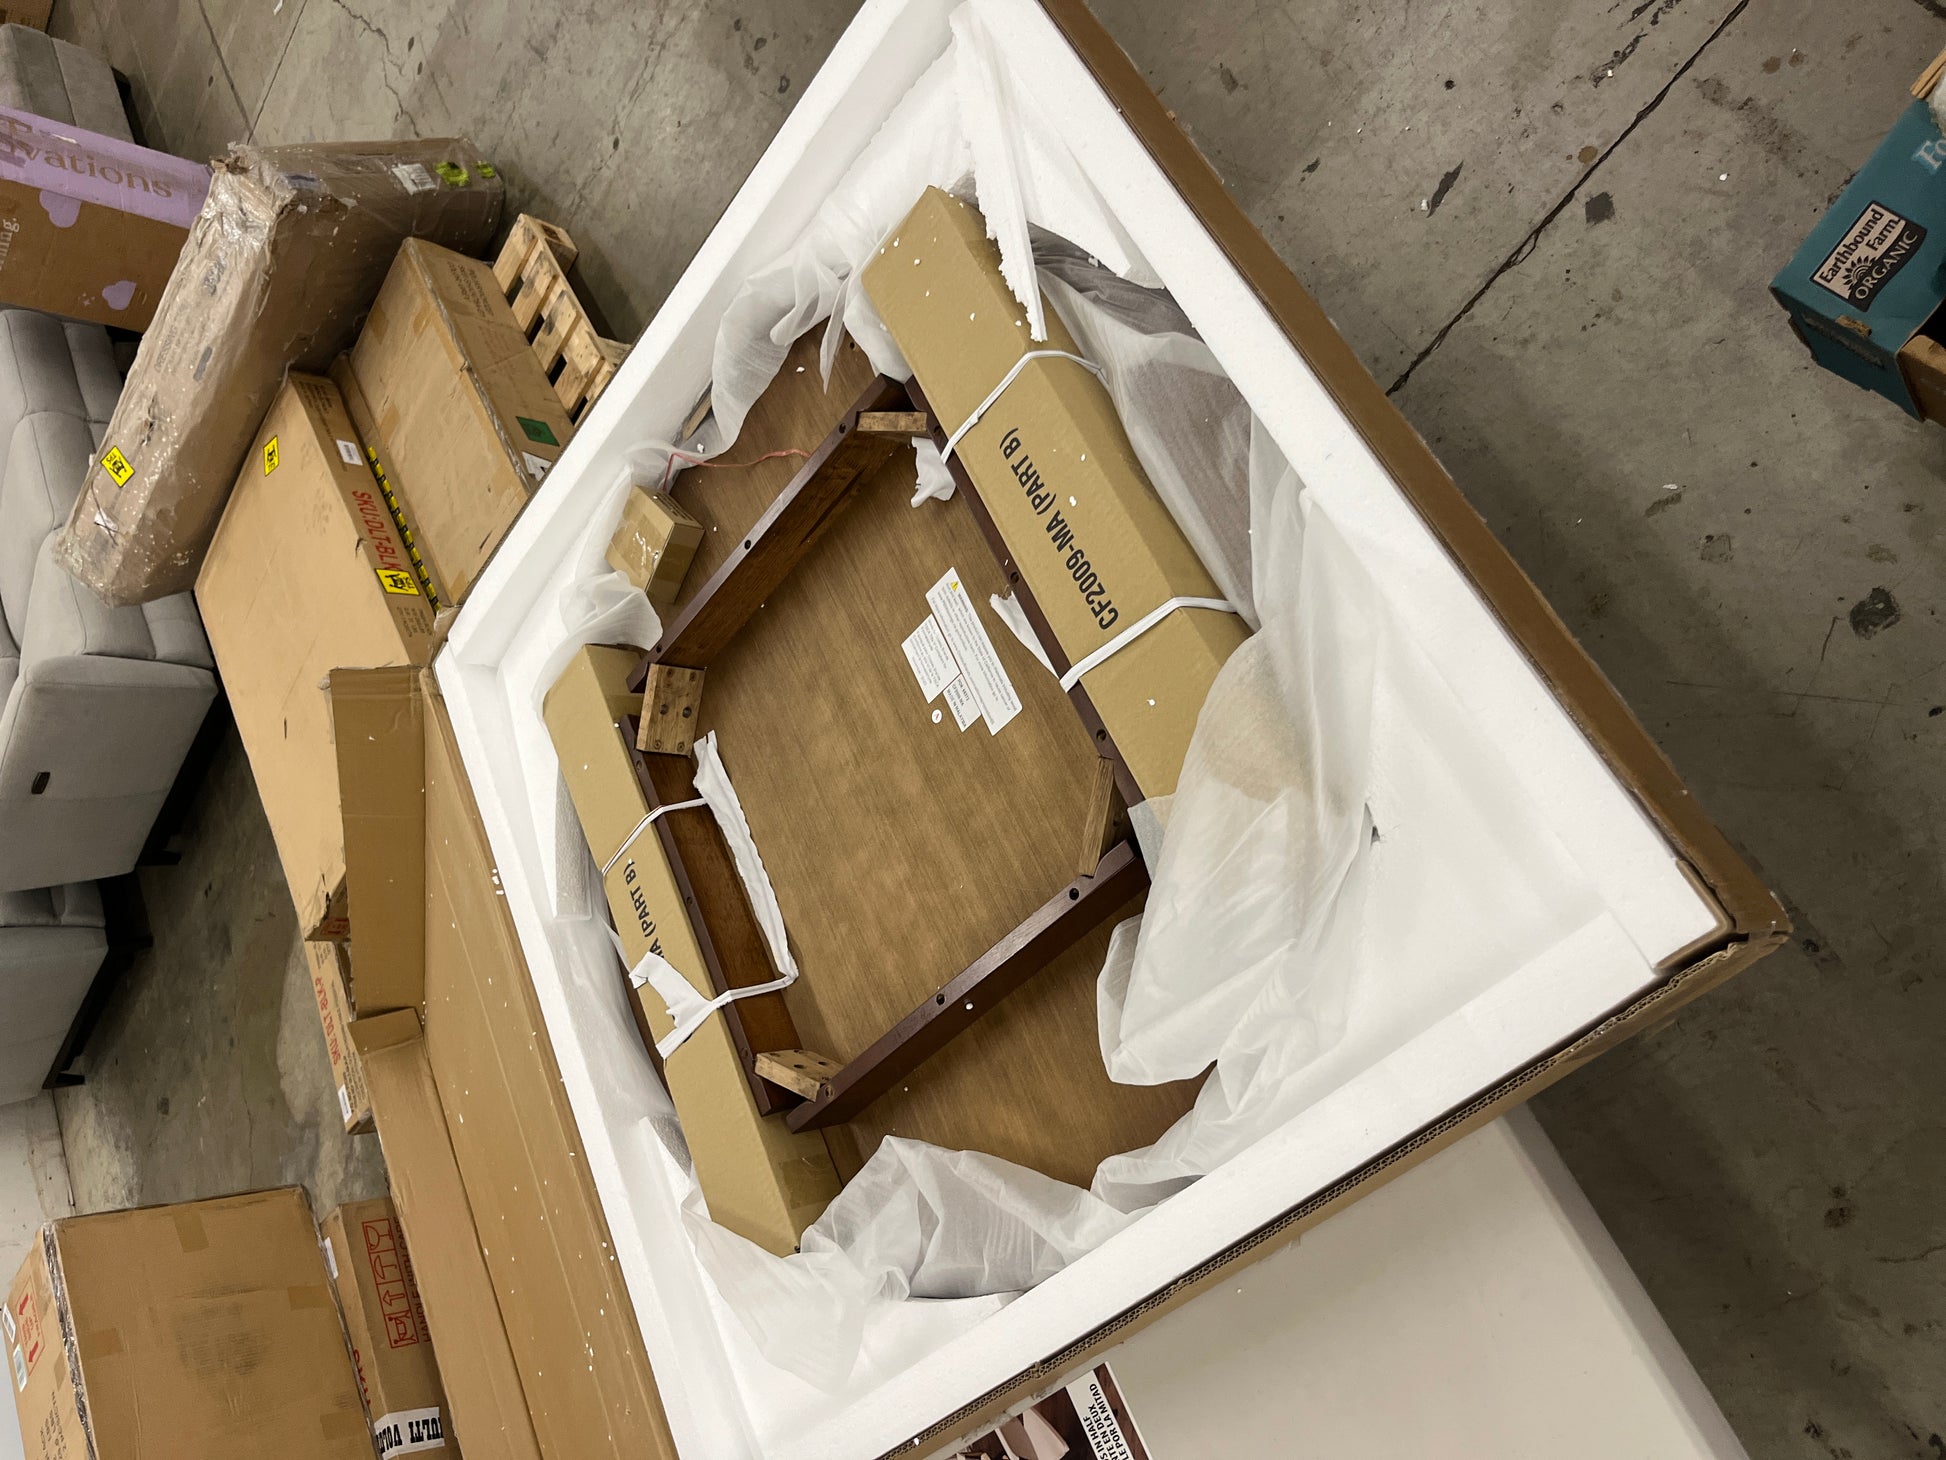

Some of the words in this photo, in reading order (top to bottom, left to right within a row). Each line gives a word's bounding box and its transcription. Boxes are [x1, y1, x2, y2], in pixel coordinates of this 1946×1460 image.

[1818, 208, 1884, 283] Earthbound
[1855, 230, 1918, 300] ORGANIC
[1000, 428, 1021, 460] B)
[1011, 455, 1056, 516] (PART
[1046, 510, 1119, 630] CF2009-MA
[624, 861, 636, 885] B)
[630, 885, 656, 937] (PART
[1089, 1383, 1108, 1414] MITAD
[1083, 1416, 1099, 1441] HALF
[1088, 1403, 1105, 1430] DEUX
[1103, 1414, 1114, 1428] LA
[1094, 1442, 1104, 1453] IN
[1100, 1430, 1110, 1445] EN
[1109, 1427, 1123, 1449] POR
